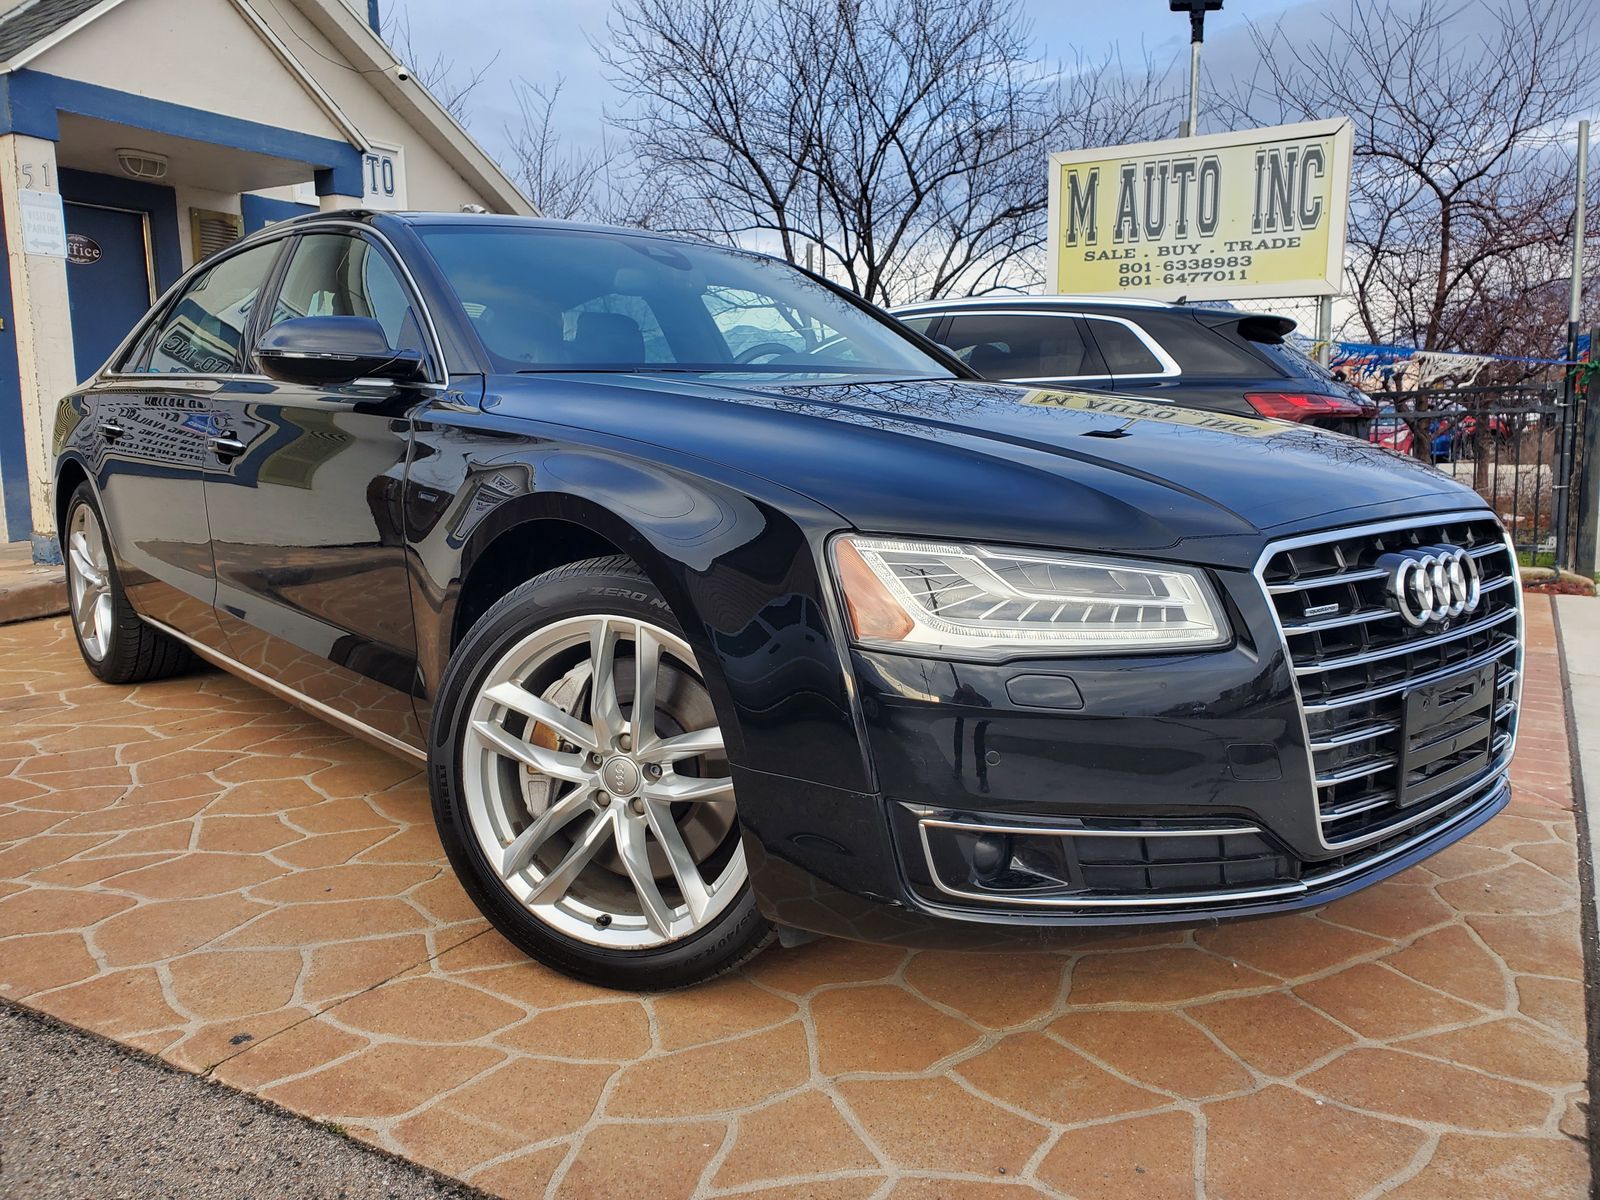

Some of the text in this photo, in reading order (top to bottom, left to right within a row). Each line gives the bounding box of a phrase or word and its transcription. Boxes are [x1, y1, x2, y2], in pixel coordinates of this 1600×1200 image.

[366, 153, 395, 197] TO
[1066, 144, 1326, 247] M AUTO INC
[26, 223, 61, 236] PARKING
[67, 241, 101, 258] ffice
[1084, 236, 1301, 262] SALE BUY TRADE
[1118, 254, 1252, 275] 801-6338983
[1118, 269, 1248, 287] 801-6477011
[591, 586, 648, 602] ZERO
